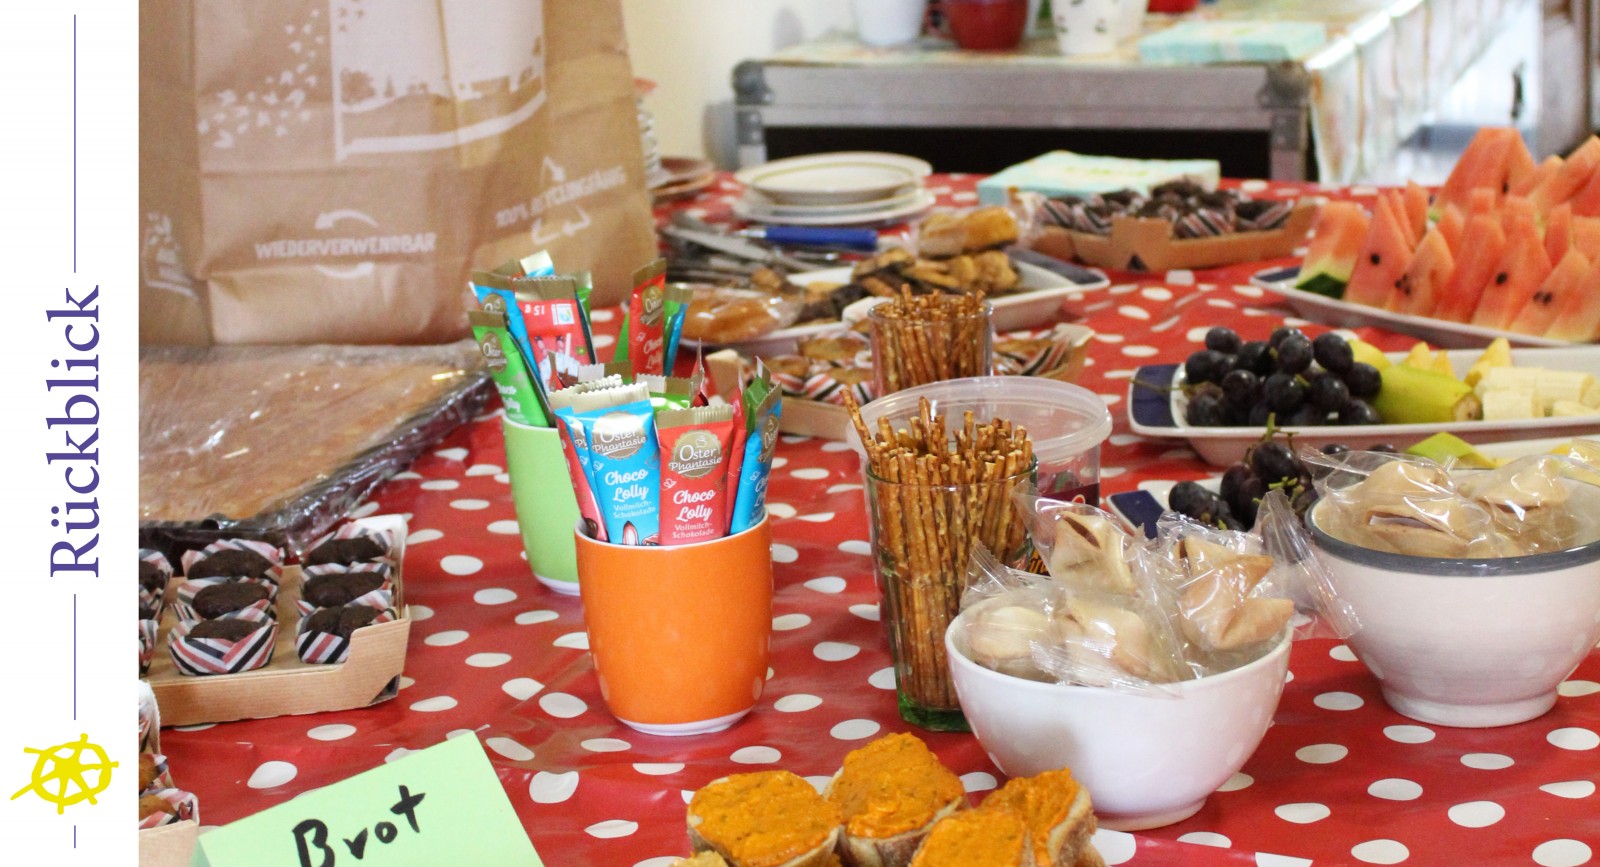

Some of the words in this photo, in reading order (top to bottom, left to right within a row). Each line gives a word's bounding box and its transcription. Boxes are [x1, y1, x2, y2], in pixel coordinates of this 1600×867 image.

[255, 231, 437, 259] WIEDERVERWENDBAR
[592, 437, 647, 456] Phantasie
[679, 444, 716, 462] Oster
[668, 456, 723, 475] Phantasie
[604, 468, 649, 486] Choco
[612, 484, 649, 503] Lolly
[673, 489, 716, 505] Choco
[613, 500, 653, 512] Vollmilch-
[613, 505, 656, 520] Schokolade
[676, 505, 713, 522] Lolly
[672, 528, 715, 540] Schokolade
[674, 521, 713, 532] Vollmilch-
[292, 785, 426, 867] Brot
